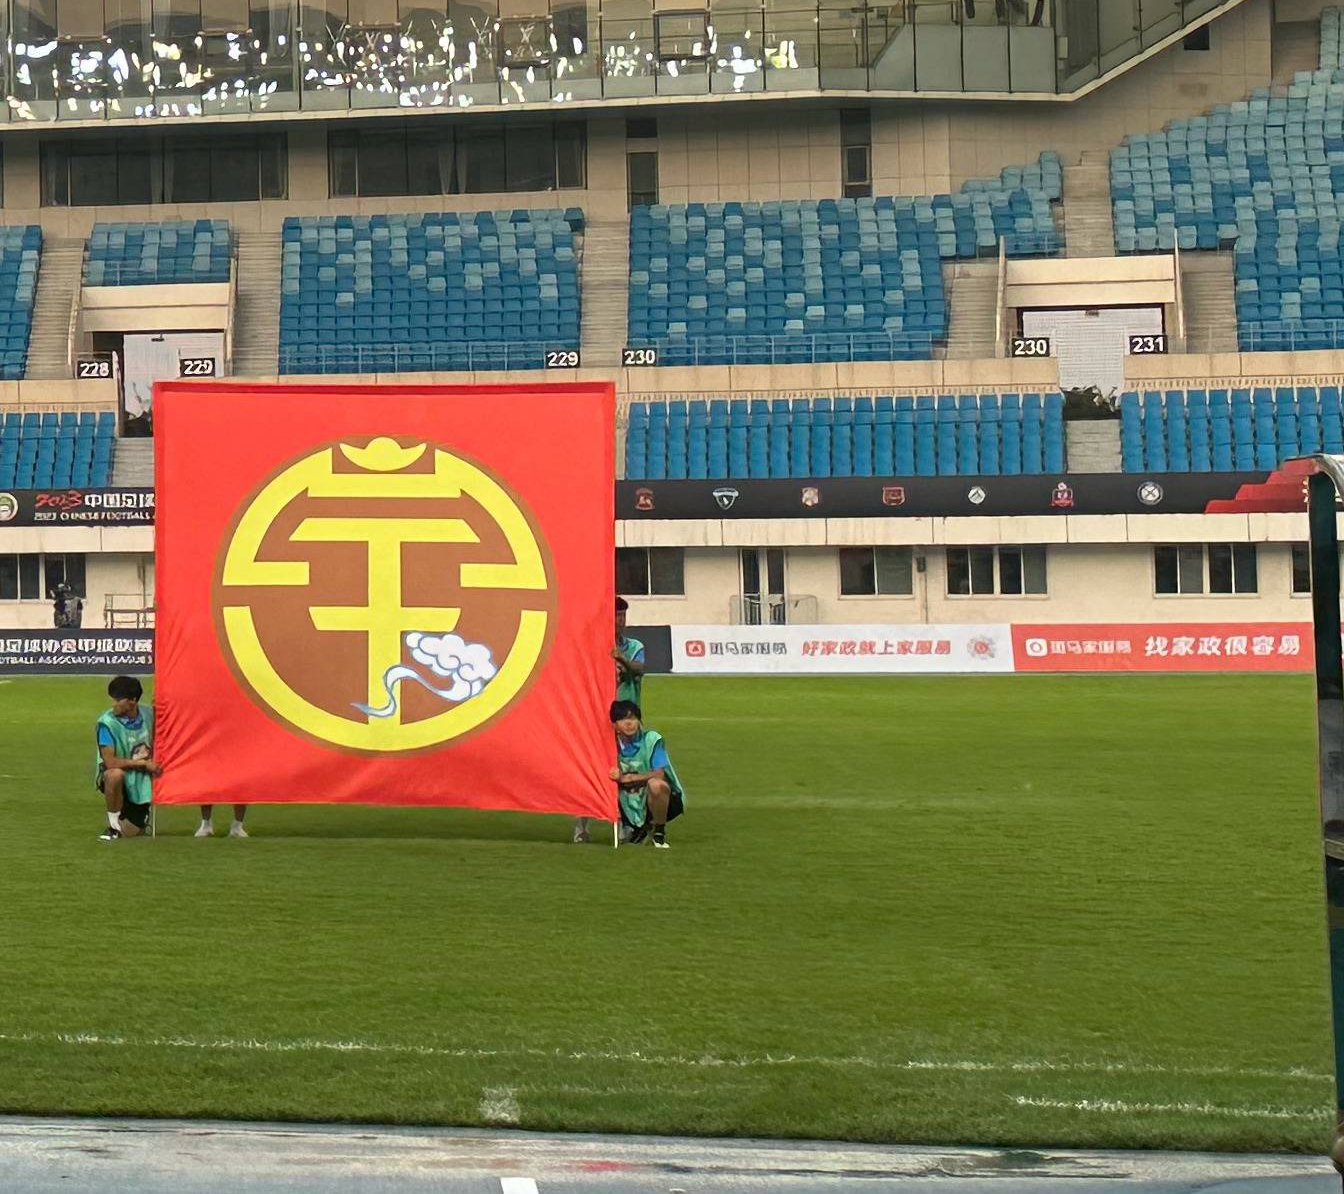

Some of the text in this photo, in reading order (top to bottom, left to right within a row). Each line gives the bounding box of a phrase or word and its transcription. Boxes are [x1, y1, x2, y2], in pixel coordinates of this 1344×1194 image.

[1014, 339, 1048, 355] 230
[1131, 337, 1165, 353] 231
[547, 351, 579, 367] 229
[624, 349, 656, 365] 230
[80, 362, 110, 377] 228
[183, 359, 213, 375] 229
